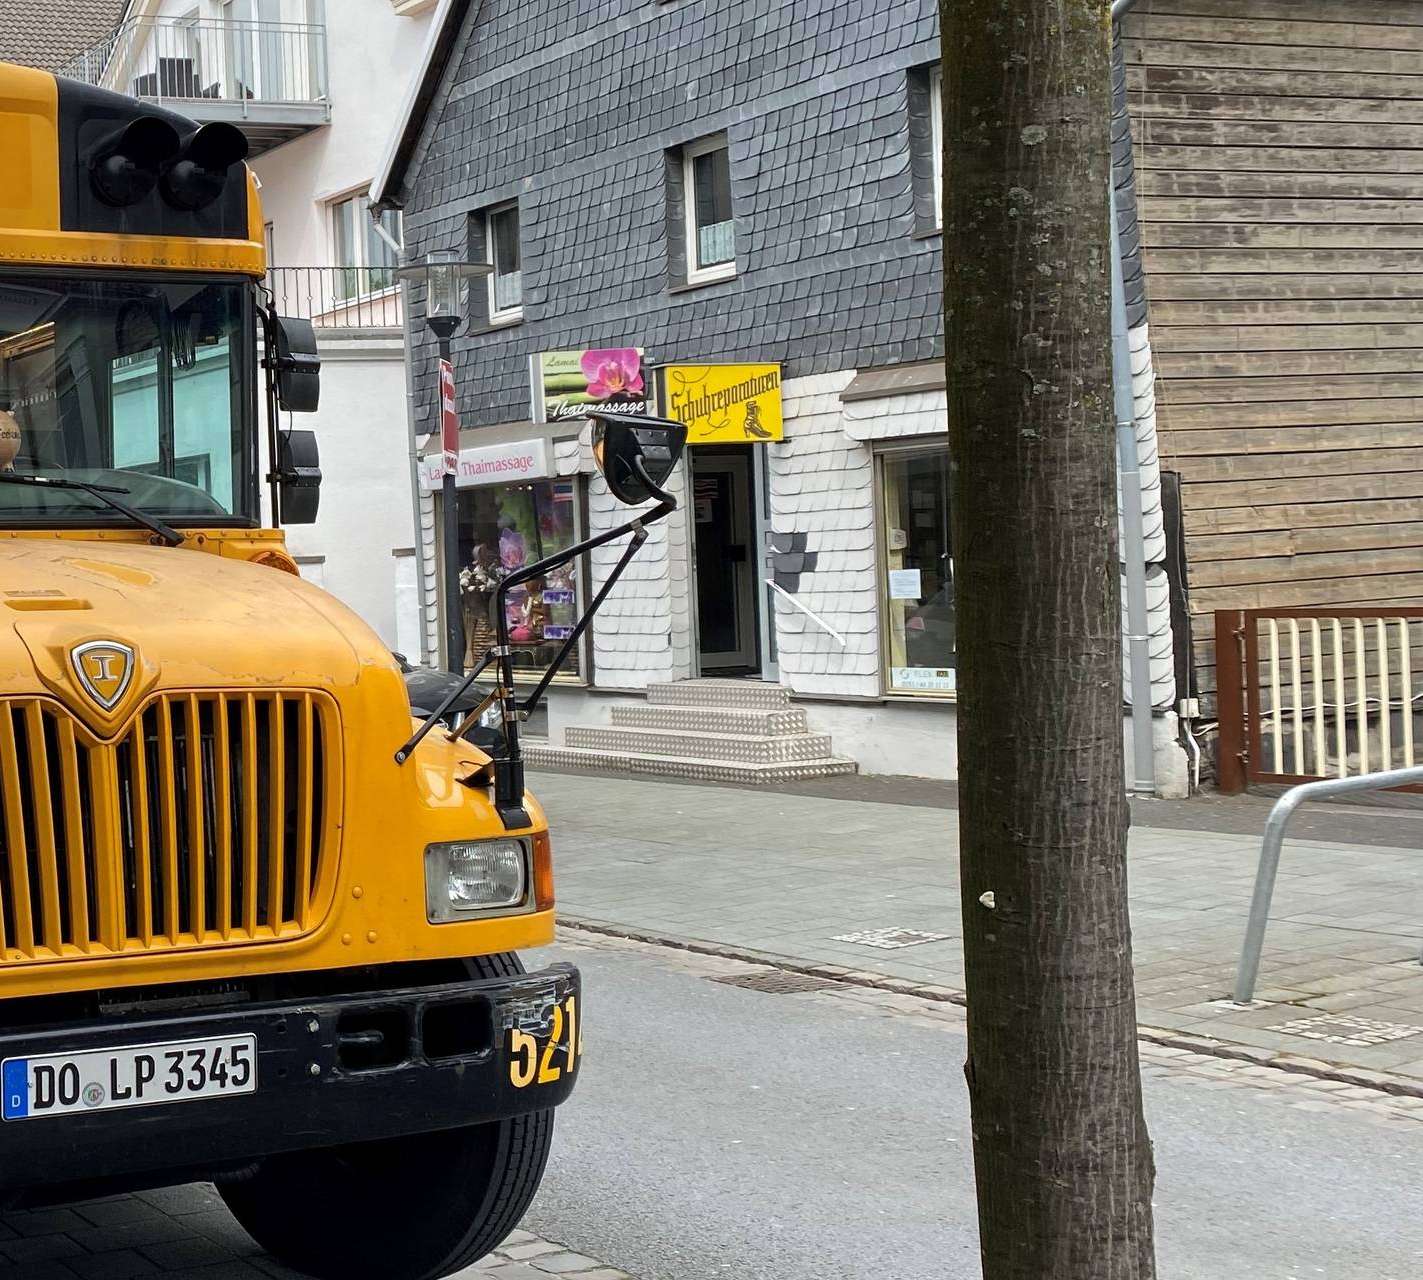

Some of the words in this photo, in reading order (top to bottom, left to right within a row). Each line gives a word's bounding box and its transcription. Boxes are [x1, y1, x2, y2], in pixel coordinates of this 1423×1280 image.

[670, 370, 779, 426] Schuhreparaturen
[461, 456, 535, 476] Thaimassage
[510, 995, 583, 1088] 521
[11, 1095, 21, 1107] D
[33, 1062, 80, 1109] DO
[110, 1055, 155, 1100] LP
[164, 1044, 249, 1094] 3345
